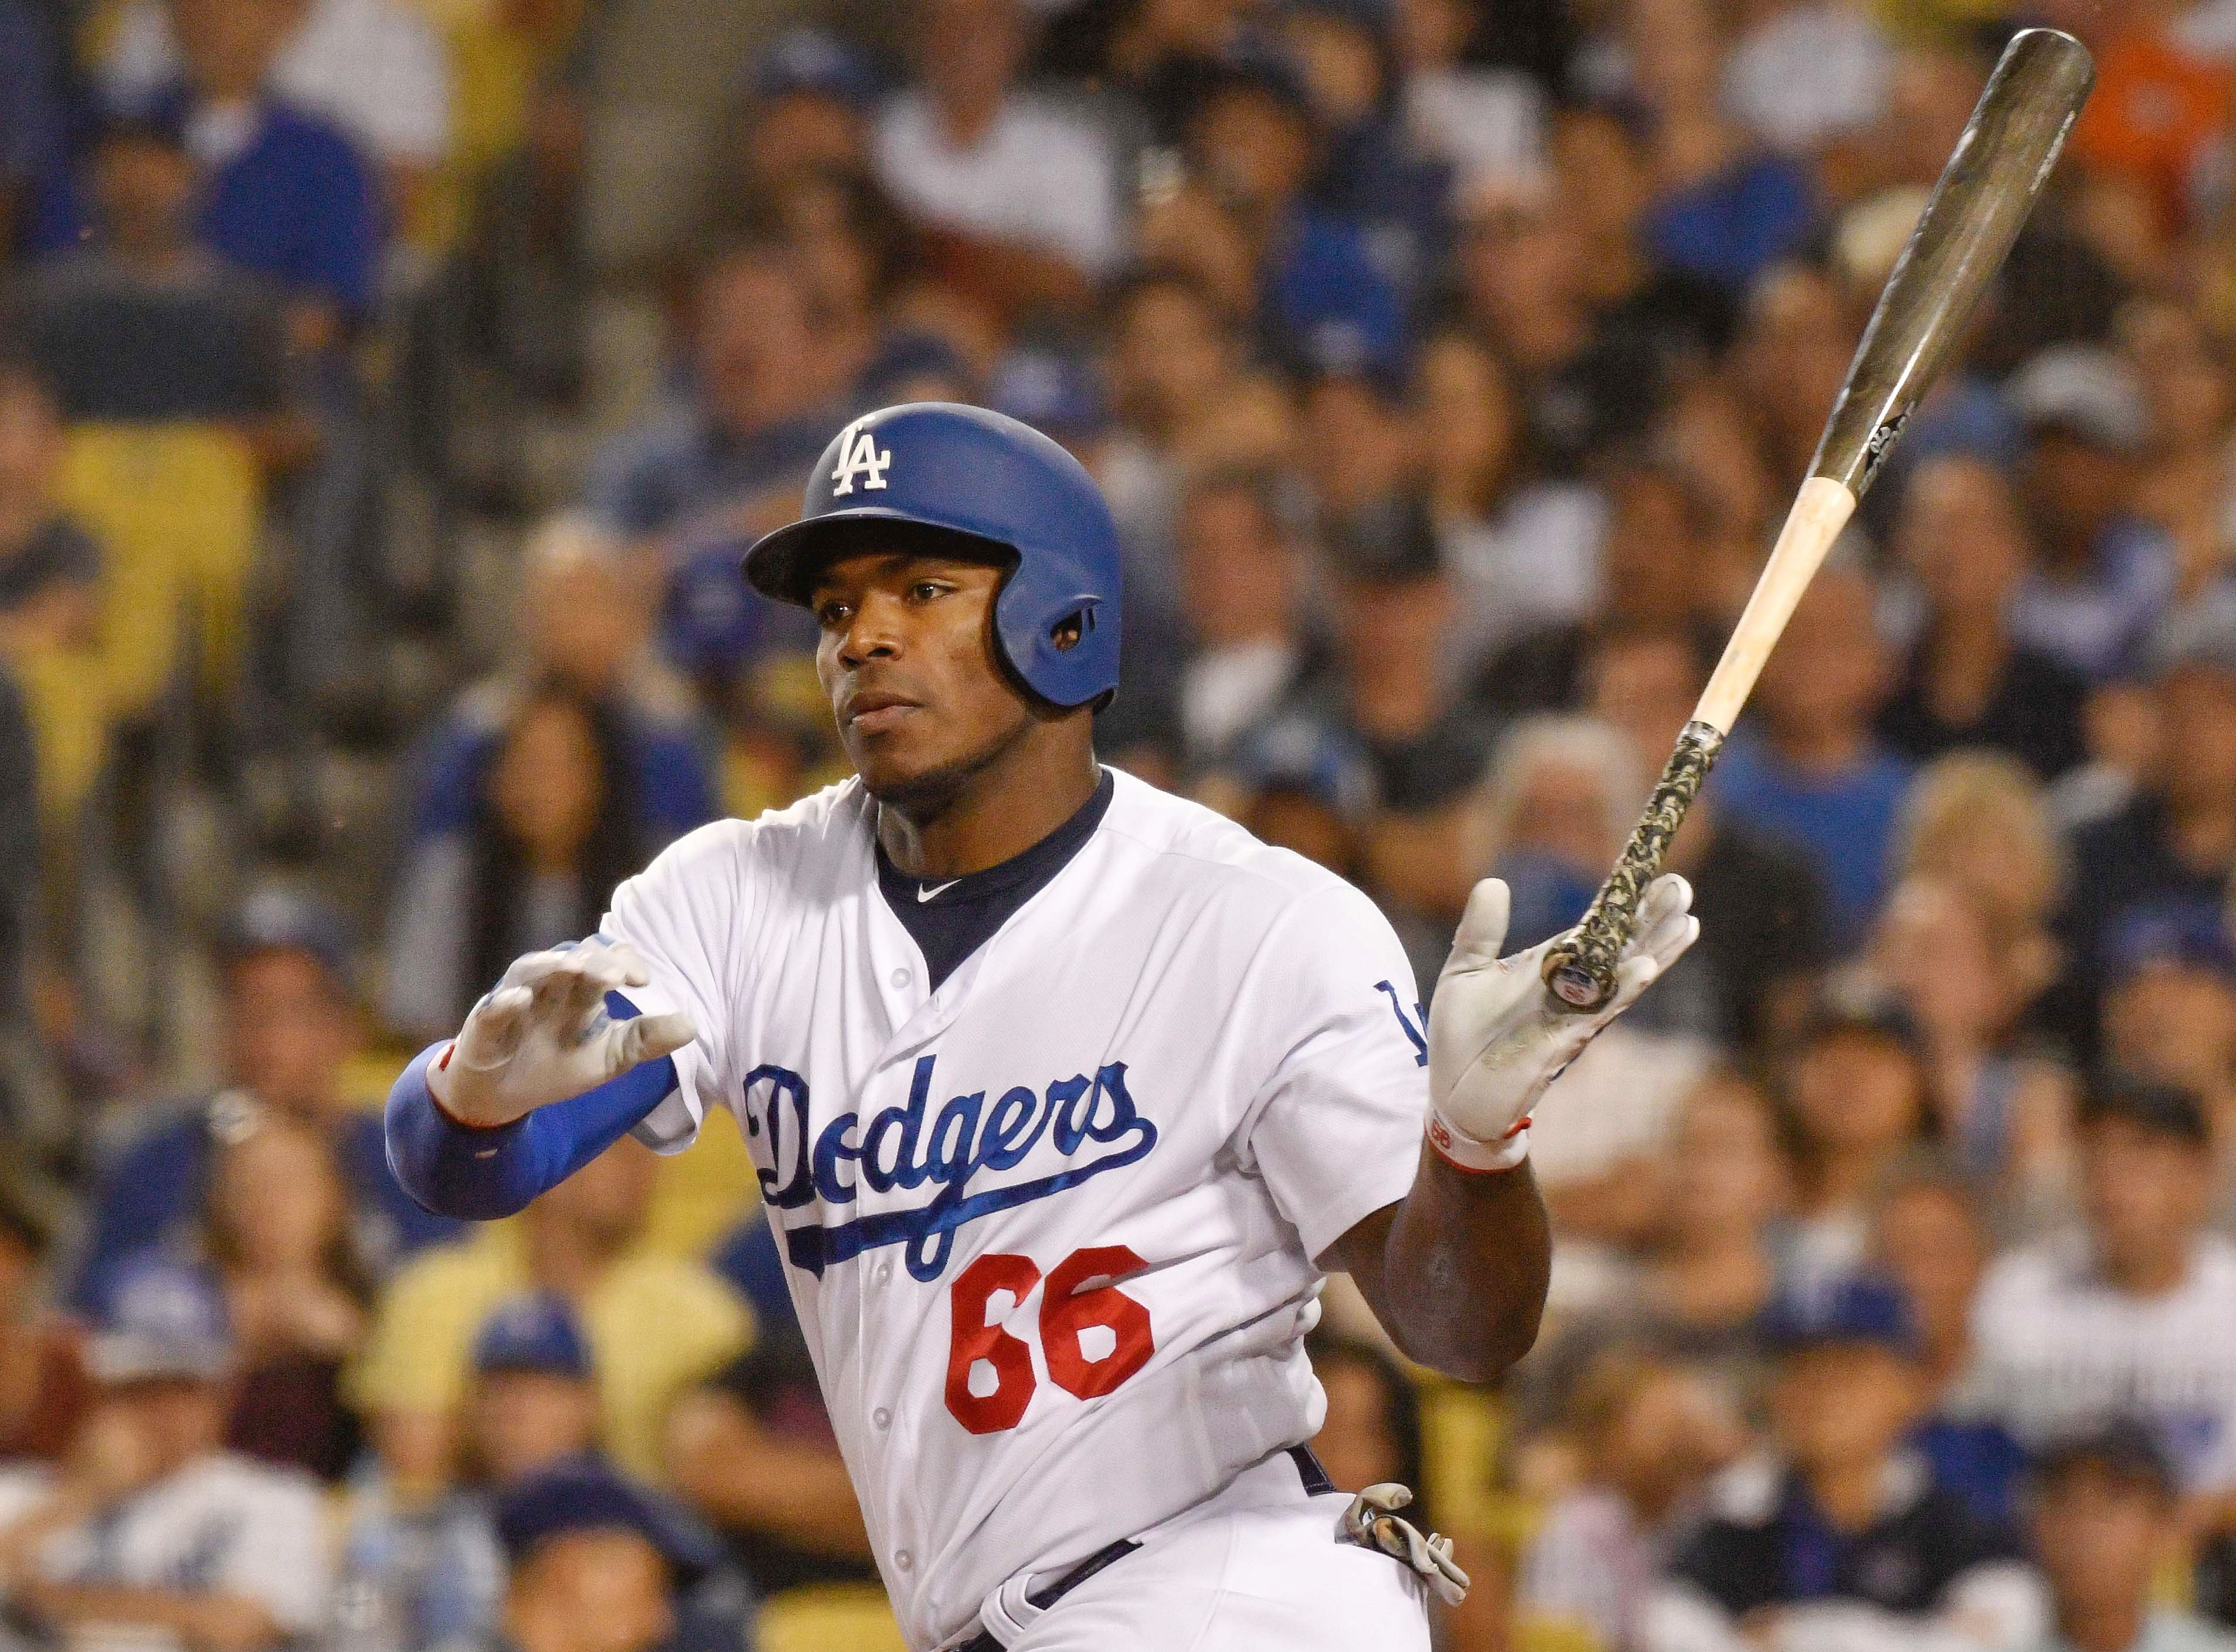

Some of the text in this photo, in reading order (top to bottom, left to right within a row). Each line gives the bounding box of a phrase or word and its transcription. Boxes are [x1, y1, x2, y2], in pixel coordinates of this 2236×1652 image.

[832, 420, 890, 497] LA
[743, 1054, 1157, 1283] Dodgers
[945, 1244, 1155, 1434] 66
